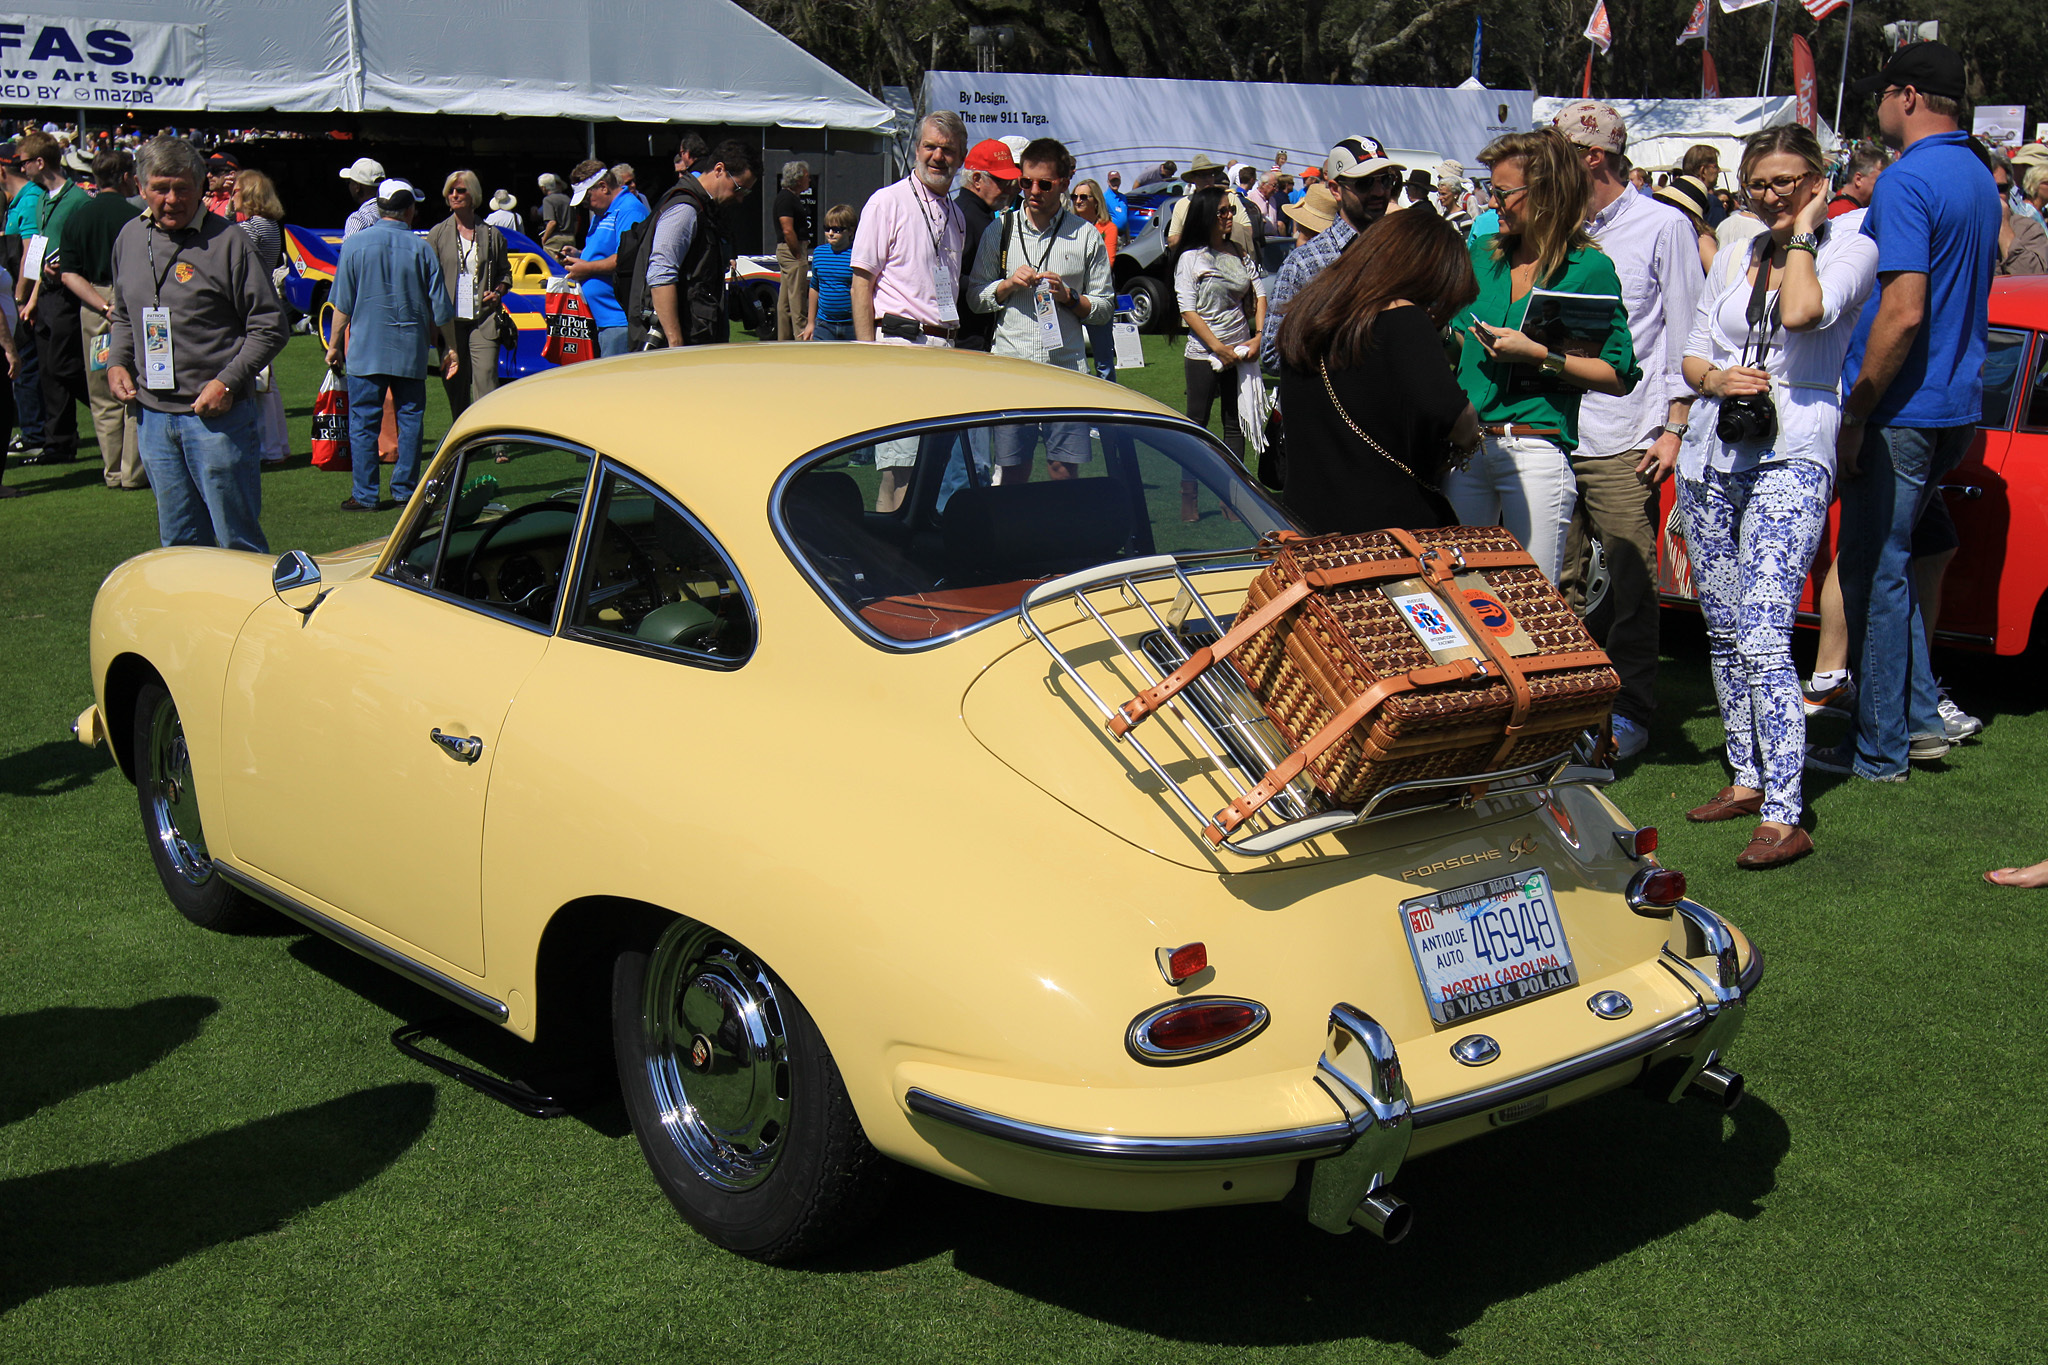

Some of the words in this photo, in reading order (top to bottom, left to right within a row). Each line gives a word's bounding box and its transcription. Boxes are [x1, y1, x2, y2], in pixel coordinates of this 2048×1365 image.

[0, 66, 38, 80] ve
[52, 69, 98, 83] Art
[111, 71, 185, 87] Show
[38, 86, 60, 100] BY
[960, 91, 971, 105] By
[974, 92, 1008, 106] Design.
[960, 111, 976, 123] The
[979, 115, 998, 123] new
[1000, 112, 1018, 123] 911
[1021, 112, 1049, 126] Targa.
[1401, 849, 1502, 882] PORSCHE
[1509, 833, 1538, 863] SC
[1440, 884, 1485, 905] MANHATTAN
[1489, 877, 1515, 897] BEACH
[1415, 911, 1432, 931] 10
[1470, 899, 1556, 965] 46948
[1421, 928, 1468, 953] ANTIQUE
[1436, 949, 1464, 969] AUTO
[1441, 973, 1492, 1000] NORTH
[1494, 954, 1560, 985] CAROLINA
[1458, 985, 1515, 1015] VASEK
[1518, 968, 1570, 998] POLAK
